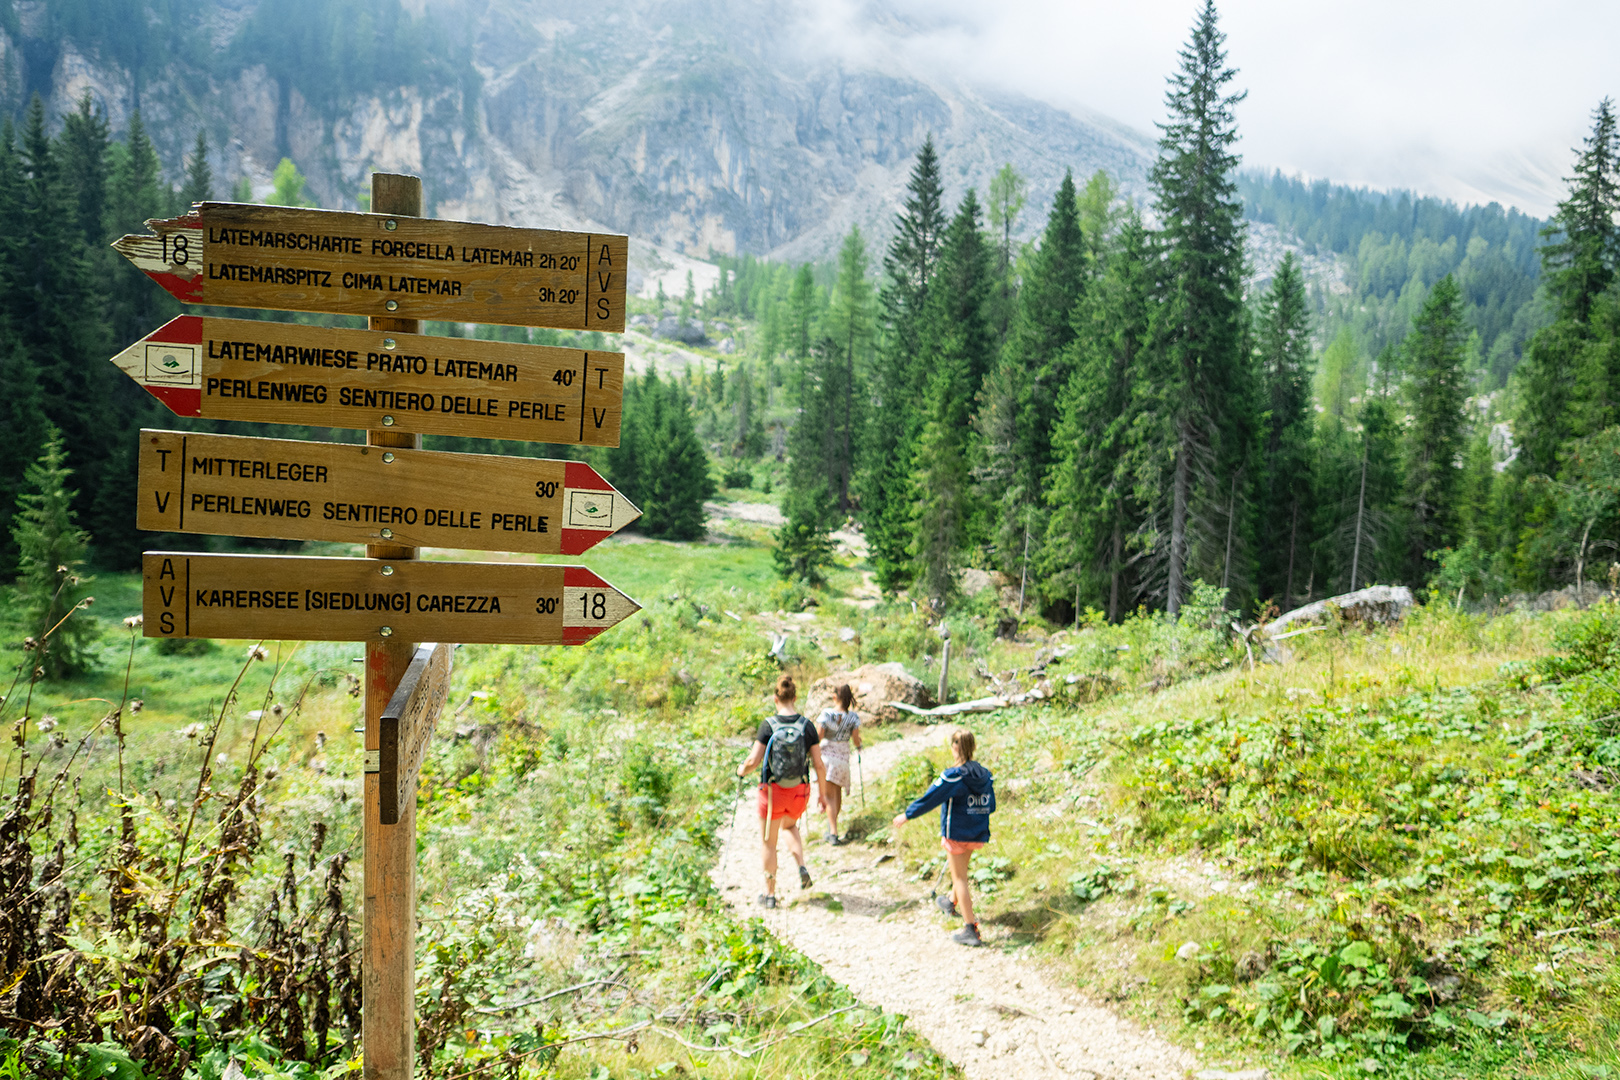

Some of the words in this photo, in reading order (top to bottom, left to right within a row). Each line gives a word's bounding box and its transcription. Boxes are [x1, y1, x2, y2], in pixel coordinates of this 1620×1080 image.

[157, 233, 189, 267] 18
[209, 226, 362, 255] LATEMARSCHARTE
[371, 239, 455, 262] FORCELLA
[462, 246, 534, 268] LATEMAR
[539, 253, 557, 270] 2h
[559, 255, 581, 271] 20'
[208, 262, 332, 288] LATEMARSPITZ
[342, 271, 384, 291] CIMA
[388, 275, 462, 297] LATEMAR
[538, 287, 556, 303] 3h
[558, 288, 581, 305] 20'
[208, 339, 359, 370] LATEMARWIESE
[366, 352, 428, 375] PRATO
[434, 358, 518, 382] LATEMAR
[552, 369, 577, 387] 40'
[207, 377, 328, 404] PERLENWEG
[339, 386, 435, 412] SENTIERO
[441, 395, 499, 417] DELLE
[508, 400, 566, 422] PERLE
[192, 456, 328, 483] MITTERLEGER
[535, 480, 560, 499] 30'
[191, 493, 311, 519] PERLENWEG
[323, 501, 418, 525] SENTIERO
[424, 508, 482, 529] DELLE
[491, 513, 549, 533] PERLE
[196, 589, 299, 609] KARERSEE
[305, 589, 411, 614] [SIEDLUNG]
[416, 594, 501, 614] CAREZZA
[535, 597, 560, 615] 30'
[579, 592, 606, 620] 18
